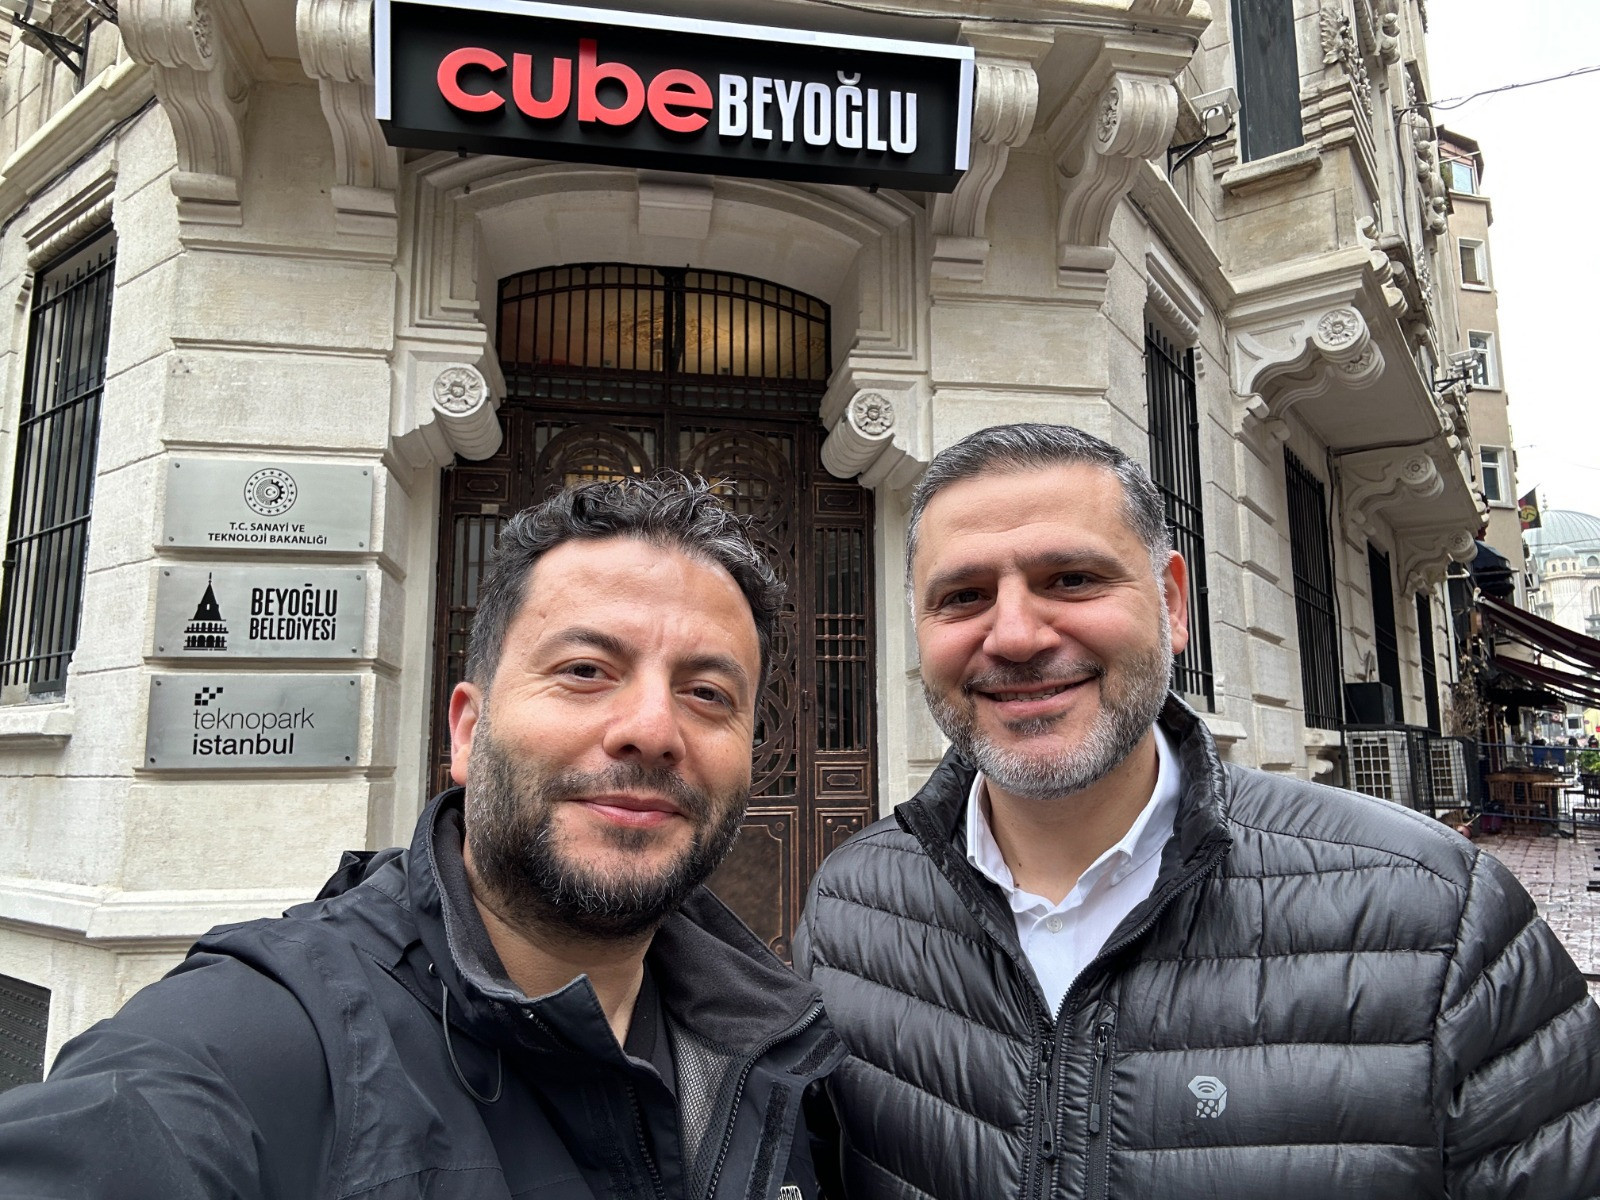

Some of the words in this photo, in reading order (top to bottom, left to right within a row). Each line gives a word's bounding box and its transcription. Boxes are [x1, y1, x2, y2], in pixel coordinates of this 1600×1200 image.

[437, 38, 714, 133] cube
[718, 70, 918, 154] BEYOĞLU
[208, 532, 267, 543] TEKNOLOJİ
[269, 534, 328, 544] BAKANLIĞI
[229, 522, 248, 531] T.C.
[250, 522, 289, 532] SANAYİ
[291, 524, 305, 533] VE
[251, 583, 338, 617] BEYOĞLU
[193, 707, 315, 734] teknopark
[192, 733, 294, 755] istanbul
